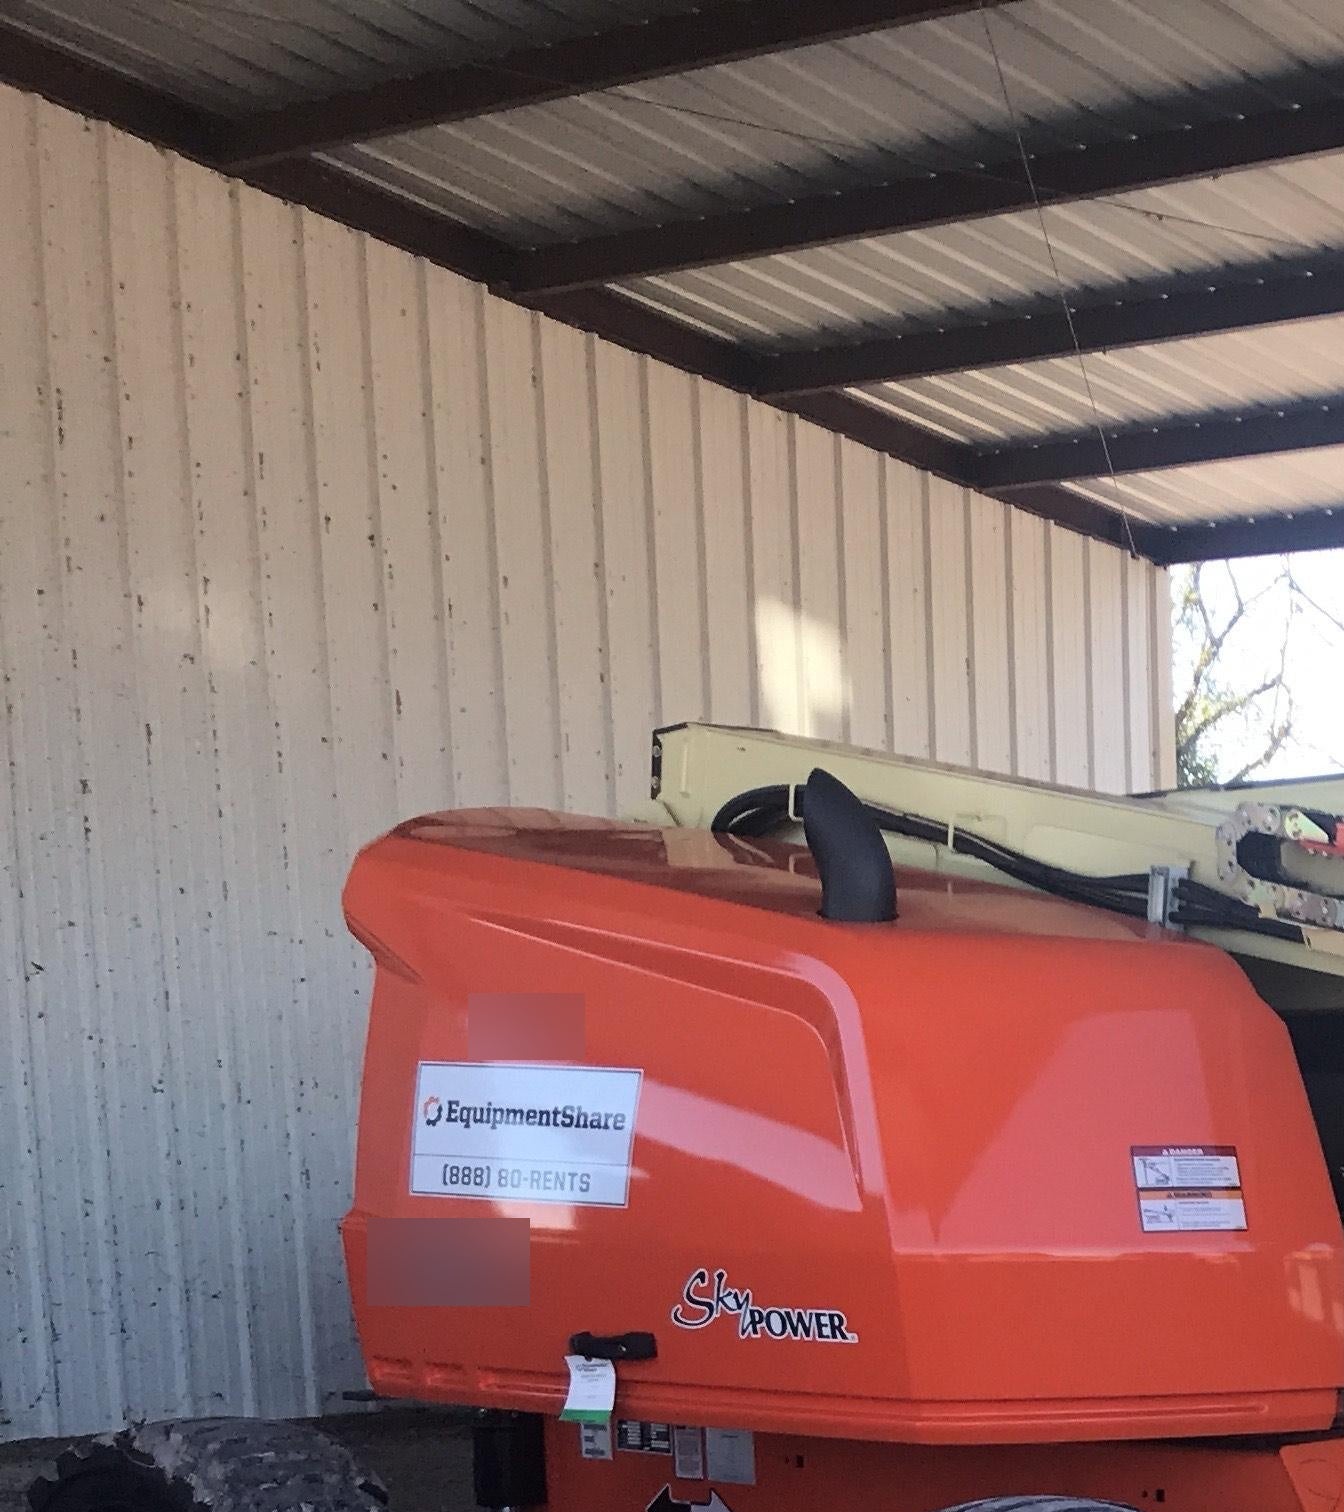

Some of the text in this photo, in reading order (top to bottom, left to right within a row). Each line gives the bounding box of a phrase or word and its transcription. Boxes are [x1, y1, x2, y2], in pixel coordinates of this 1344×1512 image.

[445, 1099, 627, 1131] EquipmentShare
[442, 1163, 592, 1193] (888) 80-RENTS
